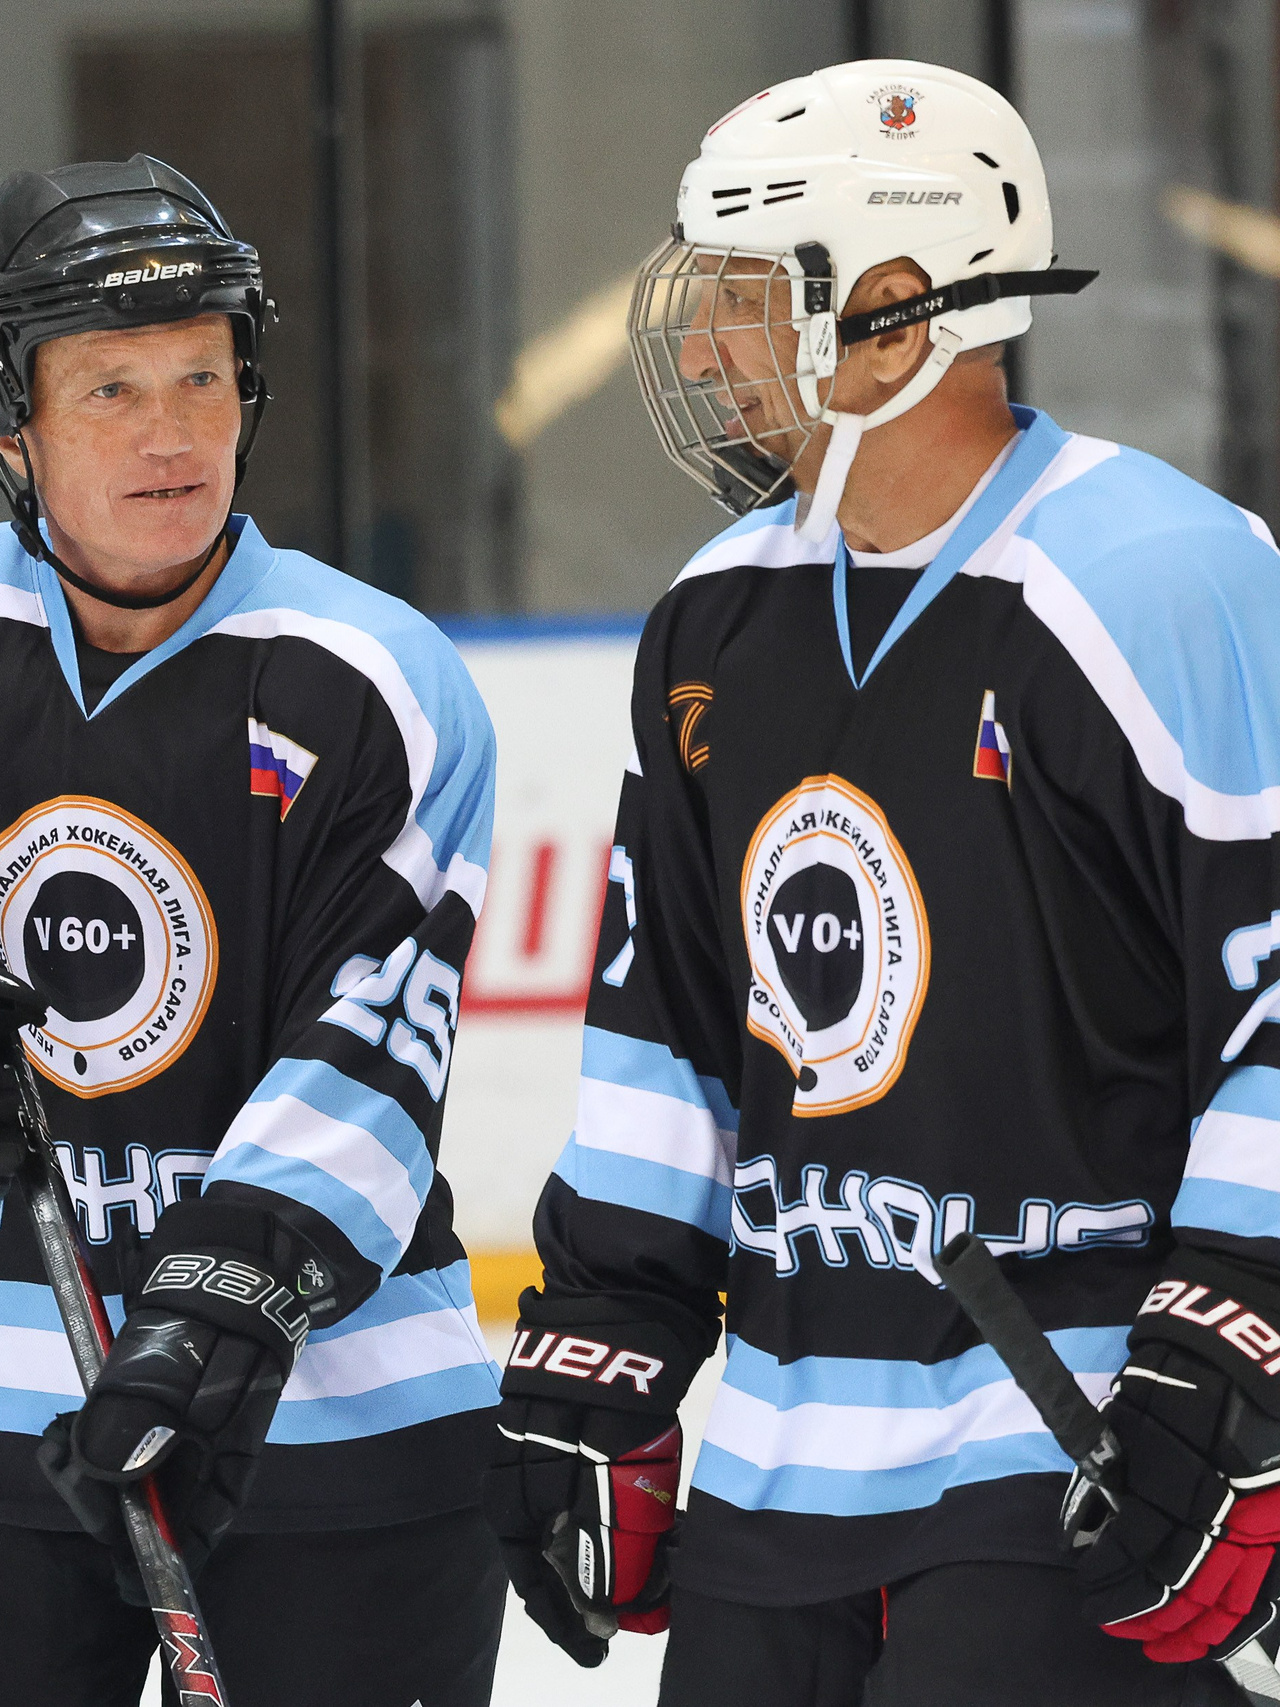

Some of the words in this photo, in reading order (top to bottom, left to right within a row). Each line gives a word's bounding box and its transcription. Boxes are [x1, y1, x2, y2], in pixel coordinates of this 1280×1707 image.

[66, 825, 171, 895] ХОКЕЙНАЯ
[58, 916, 137, 955] 60+
[163, 898, 191, 958] ЛИГА
[772, 913, 806, 964] V
[118, 977, 187, 1062] САРАТОВ
[317, 936, 461, 1103] 29
[854, 989, 895, 1073] САРАТОВ
